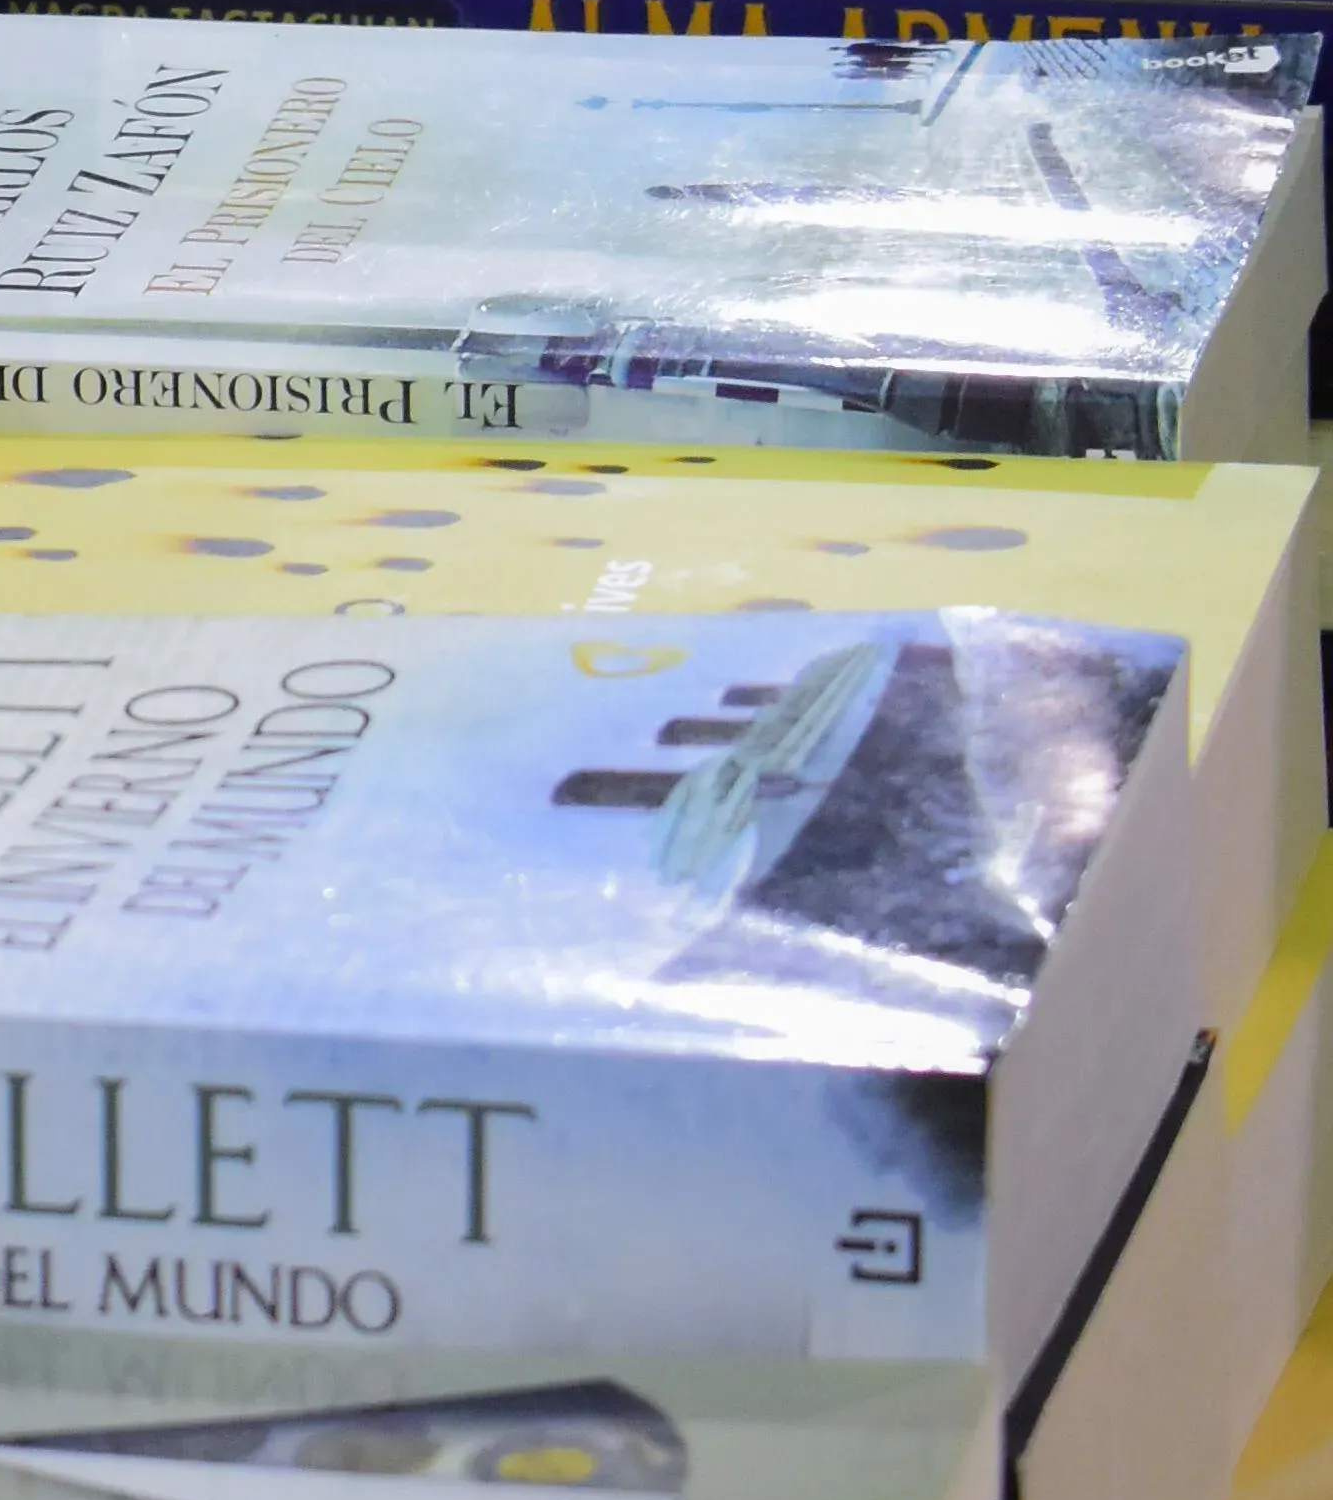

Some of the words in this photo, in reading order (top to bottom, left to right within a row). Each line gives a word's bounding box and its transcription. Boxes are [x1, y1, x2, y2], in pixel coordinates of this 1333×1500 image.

[67, 63, 230, 197] ZAFÓN
[179, 75, 349, 247] PRISIONERO
[316, 116, 425, 206] CIELO
[144, 261, 233, 297] EL
[279, 216, 369, 265] DEL
[72, 366, 419, 427] PRISIONERO
[445, 377, 527, 430] EL
[121, 860, 251, 921] DEL
[188, 657, 397, 863] MUNDO
[98, 1252, 403, 1337] MUNDO
